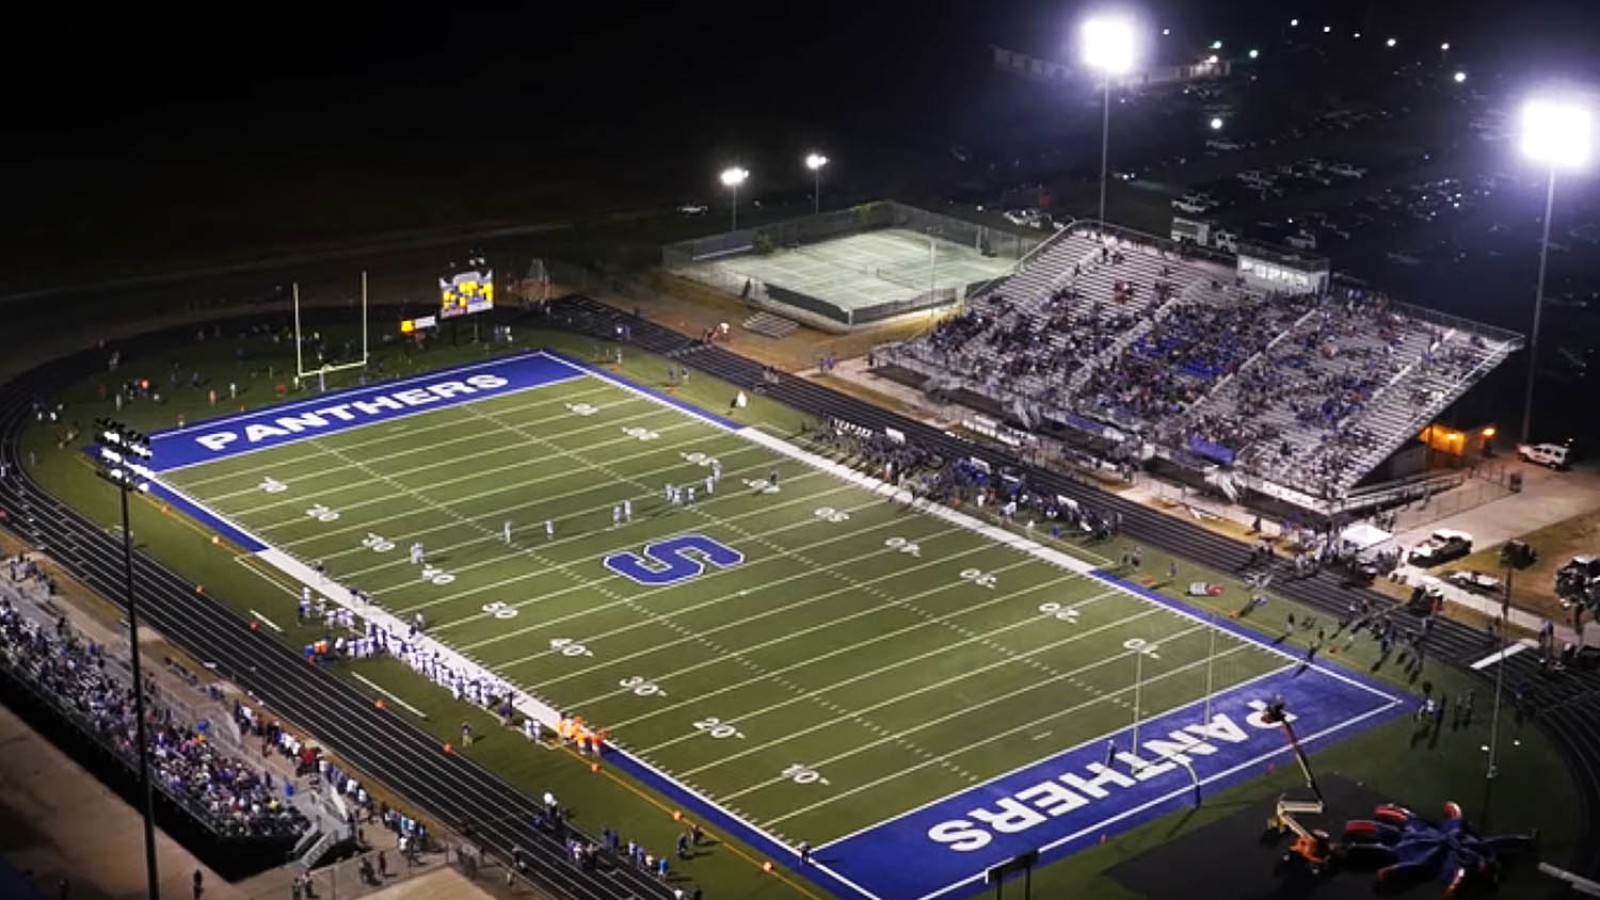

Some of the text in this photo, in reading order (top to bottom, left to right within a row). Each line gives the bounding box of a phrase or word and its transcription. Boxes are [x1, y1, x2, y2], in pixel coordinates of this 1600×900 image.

[195, 374, 509, 451] PANTHERS
[603, 532, 745, 586] S
[619, 676, 659, 696] 30
[692, 717, 736, 738] 20
[928, 699, 1298, 852] PANTHERS
